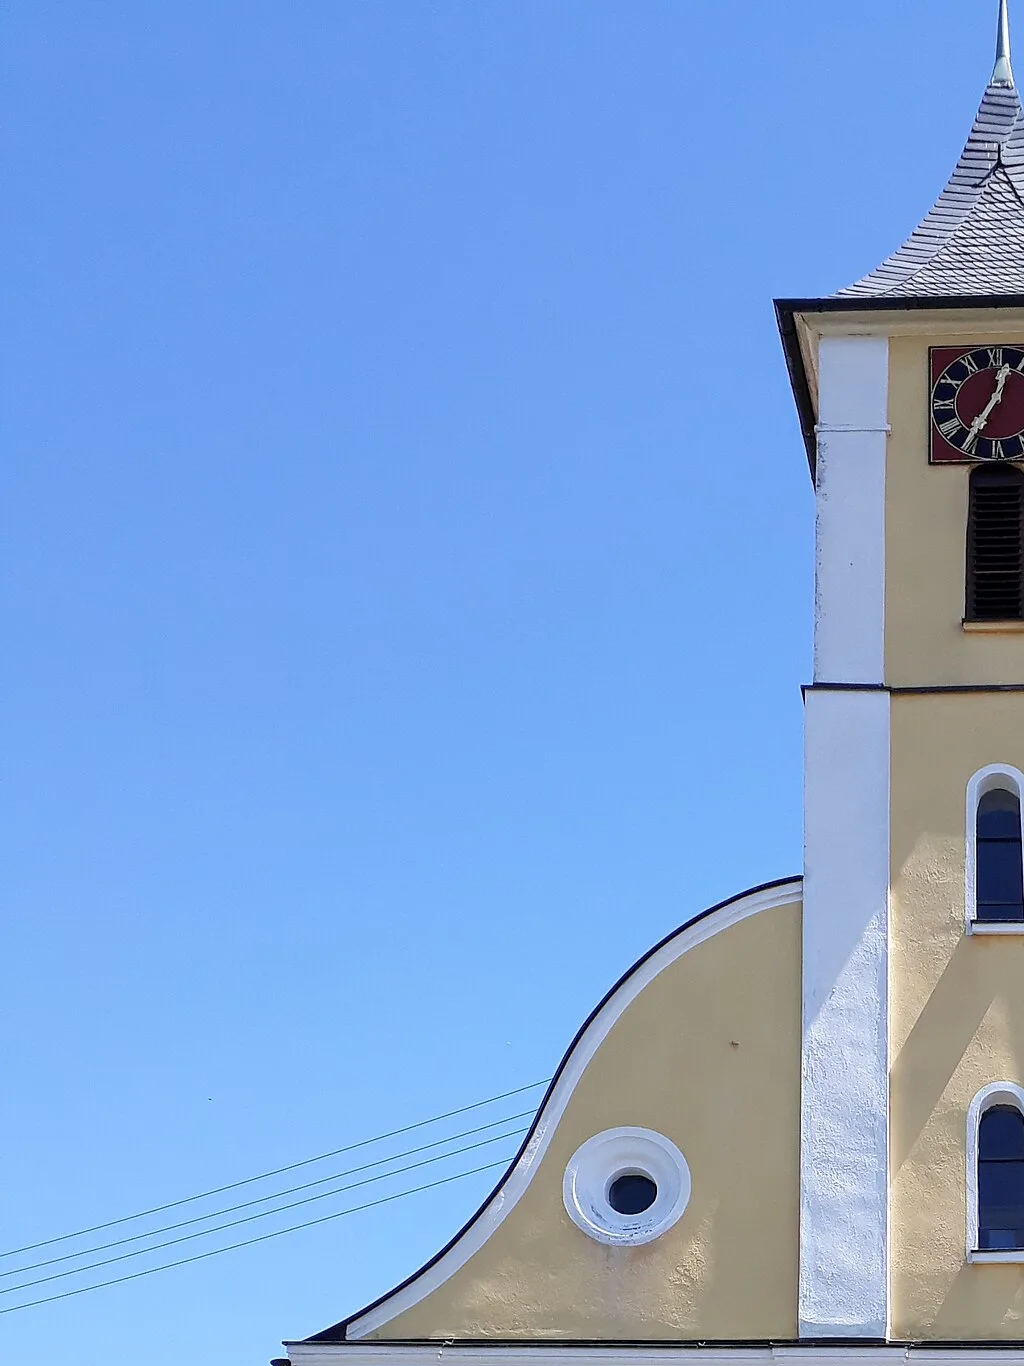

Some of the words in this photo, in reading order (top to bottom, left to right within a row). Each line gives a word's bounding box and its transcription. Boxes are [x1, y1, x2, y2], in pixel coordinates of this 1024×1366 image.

[959, 354, 979, 375] XI
[987, 349, 1003, 366] XII
[940, 373, 962, 389] X
[933, 398, 954, 410] IX
[991, 440, 1004, 458] VI
